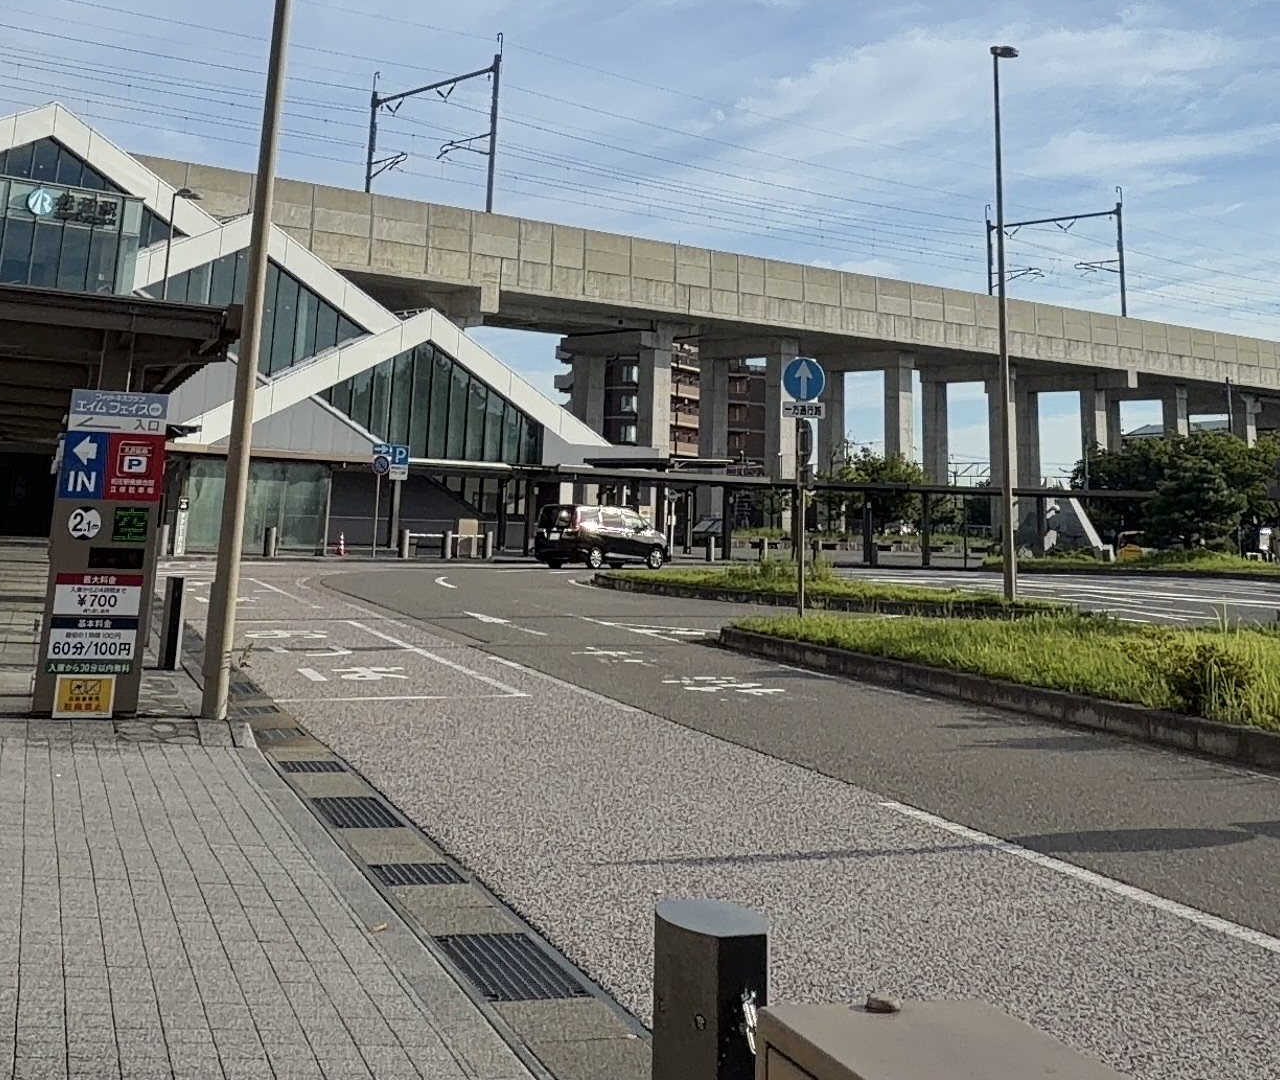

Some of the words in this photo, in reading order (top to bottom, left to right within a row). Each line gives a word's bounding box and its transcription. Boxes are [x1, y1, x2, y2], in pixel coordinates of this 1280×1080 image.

[76, 400, 107, 412] エイム
[109, 402, 149, 415] フェイス
[134, 419, 160, 432] 入口
[395, 447, 407, 463] P
[128, 459, 142, 470] P
[67, 470, 97, 493] IN
[77, 594, 118, 608] ¥700
[77, 619, 112, 628] 基本料金
[52, 641, 131, 656] 60分/100円
